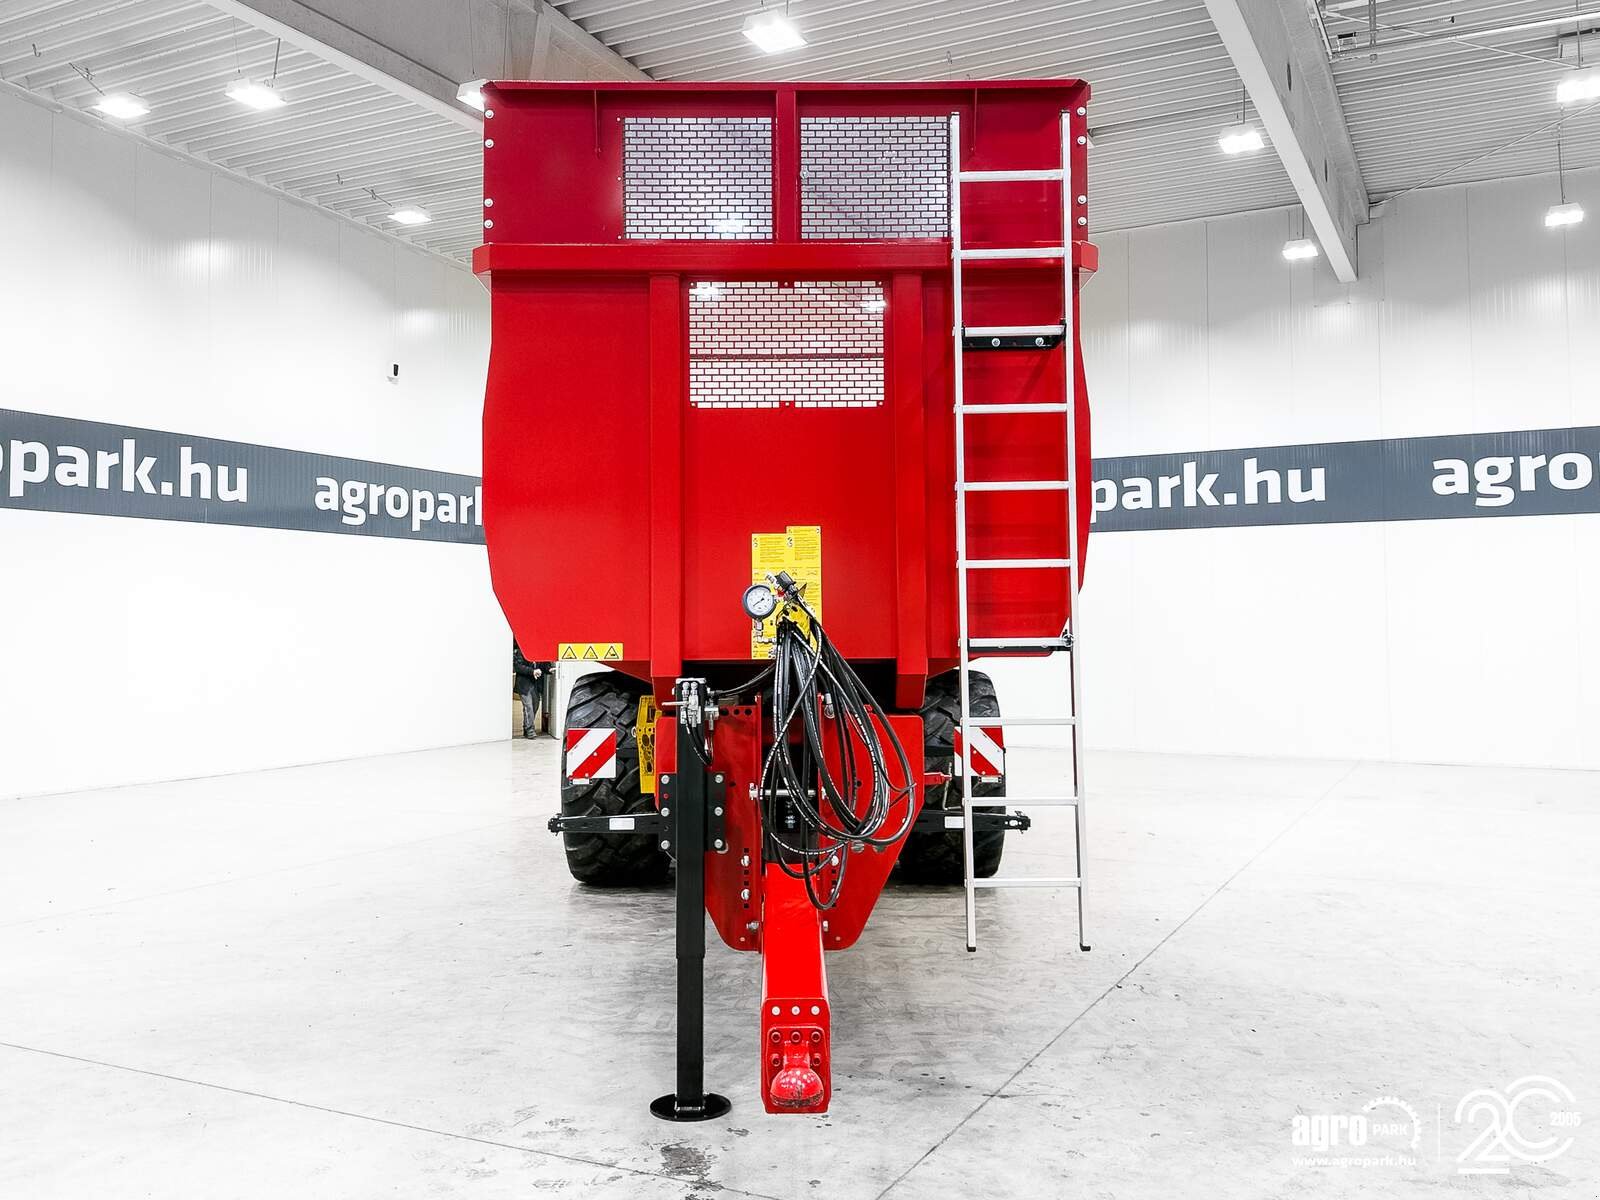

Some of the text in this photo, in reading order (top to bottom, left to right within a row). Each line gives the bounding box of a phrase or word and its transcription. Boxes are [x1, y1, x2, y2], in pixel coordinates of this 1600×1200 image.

[0, 438, 248, 503] park.hu
[1090, 457, 1326, 524] park.hu
[1432, 452, 1600, 507] agro
